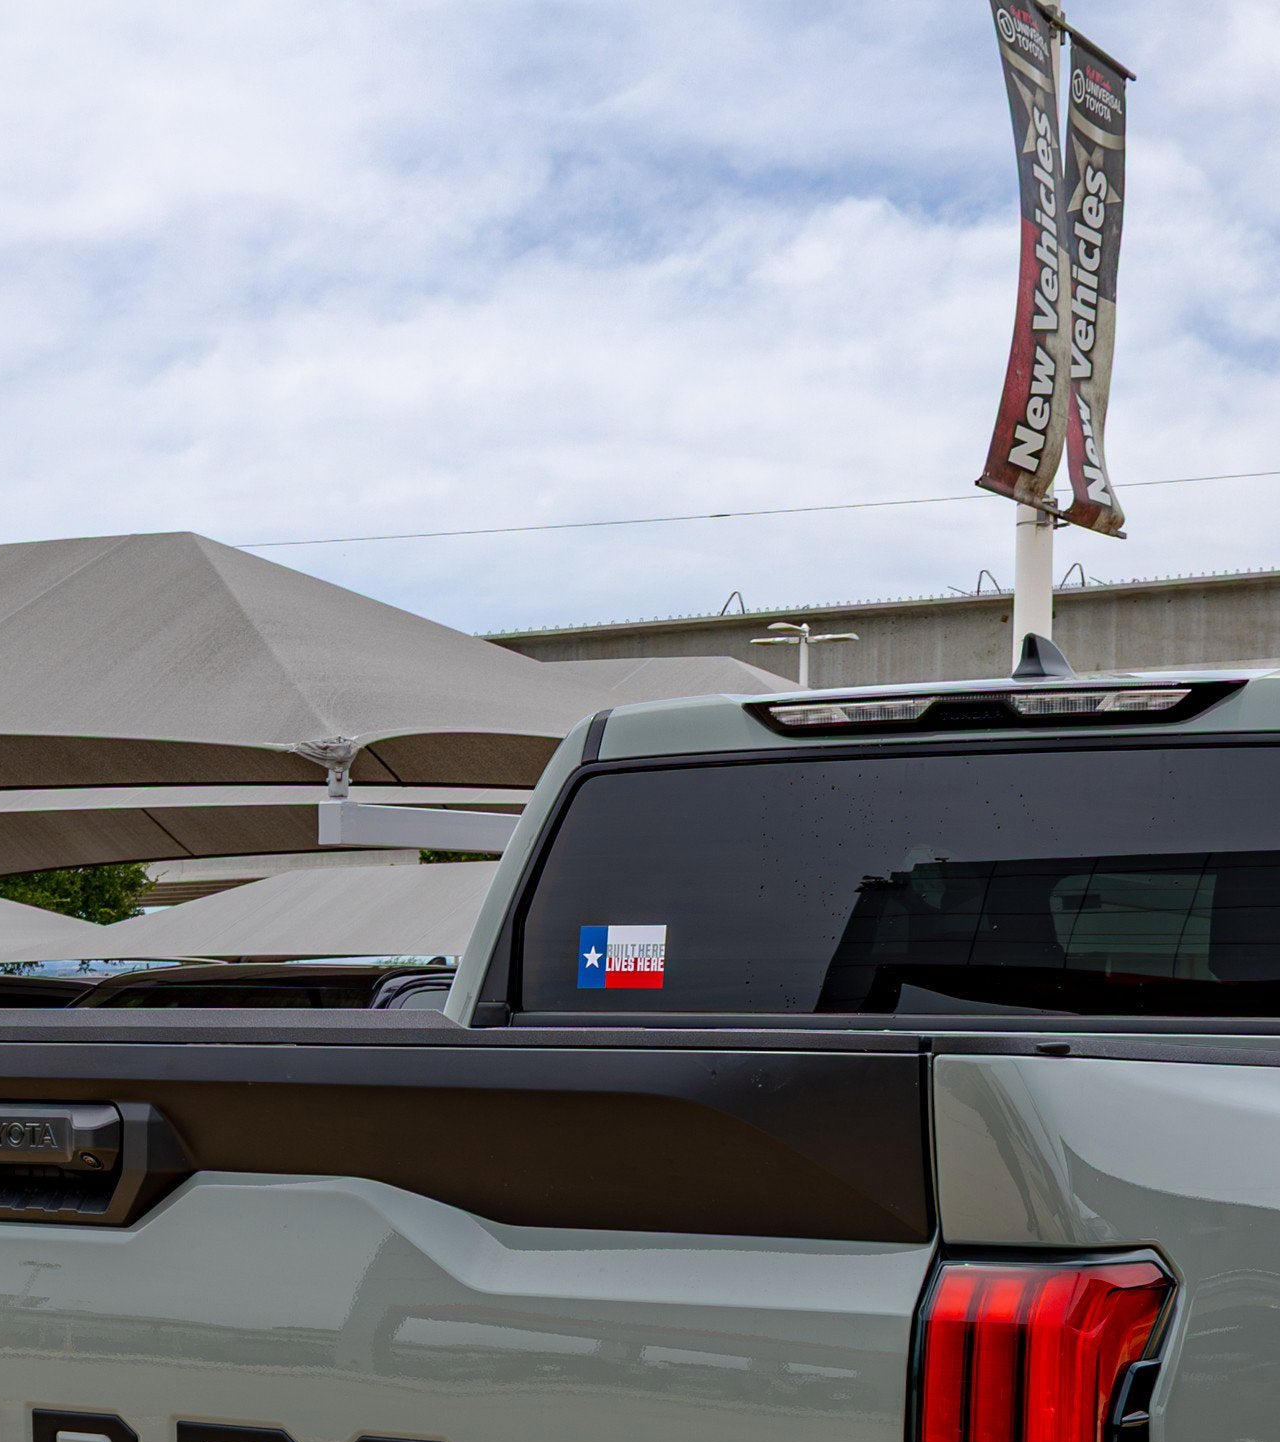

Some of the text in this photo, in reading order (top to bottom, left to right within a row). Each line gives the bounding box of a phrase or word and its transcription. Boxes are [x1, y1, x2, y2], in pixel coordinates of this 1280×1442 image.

[1016, 33, 1045, 65] TOYOTA
[1085, 79, 1123, 115] UNIVERSAL
[1085, 95, 1112, 122] TOYOTA
[1070, 163, 1108, 381] Vehicles
[1008, 105, 1059, 474] New Vehicles
[606, 957, 665, 972] LIVES HERE
[607, 943, 665, 958] BUILT HERE
